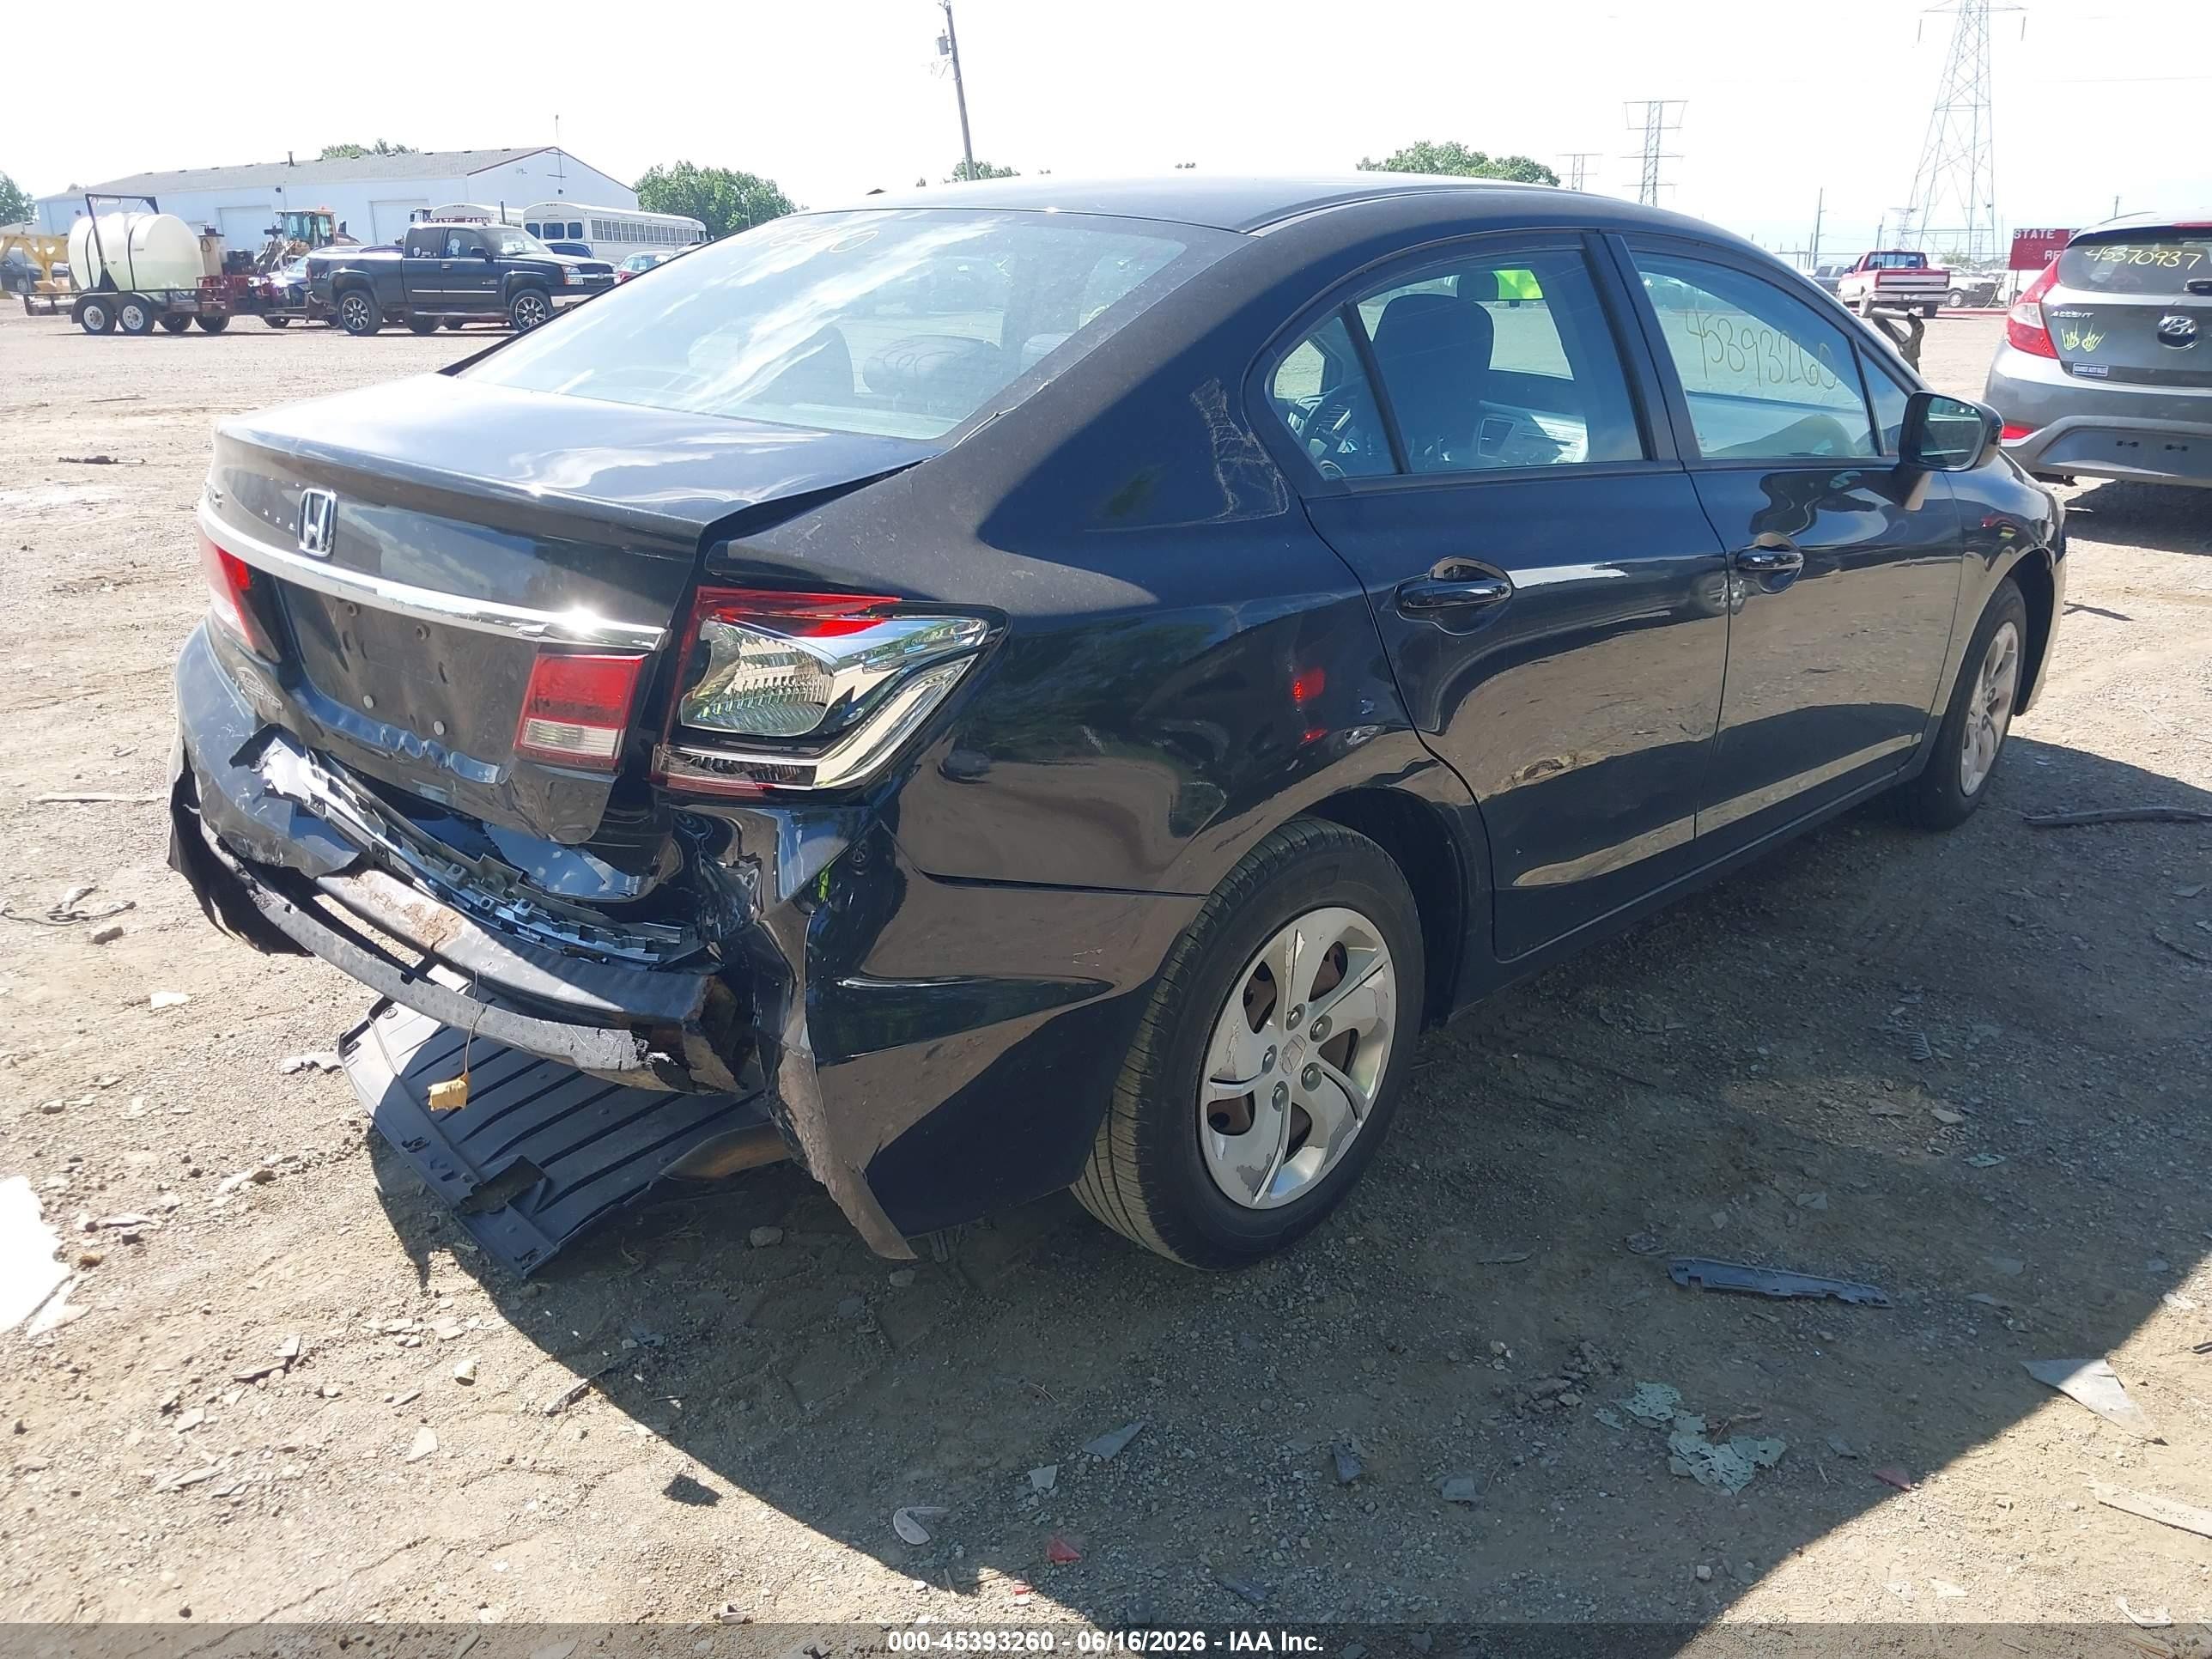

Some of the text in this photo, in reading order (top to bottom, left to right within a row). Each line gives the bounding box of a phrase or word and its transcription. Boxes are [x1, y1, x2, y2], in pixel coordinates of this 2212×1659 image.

[2014, 229, 2056, 240] STATE
[2085, 245, 2203, 270] 45370937
[1686, 305, 1837, 390] 45393260
